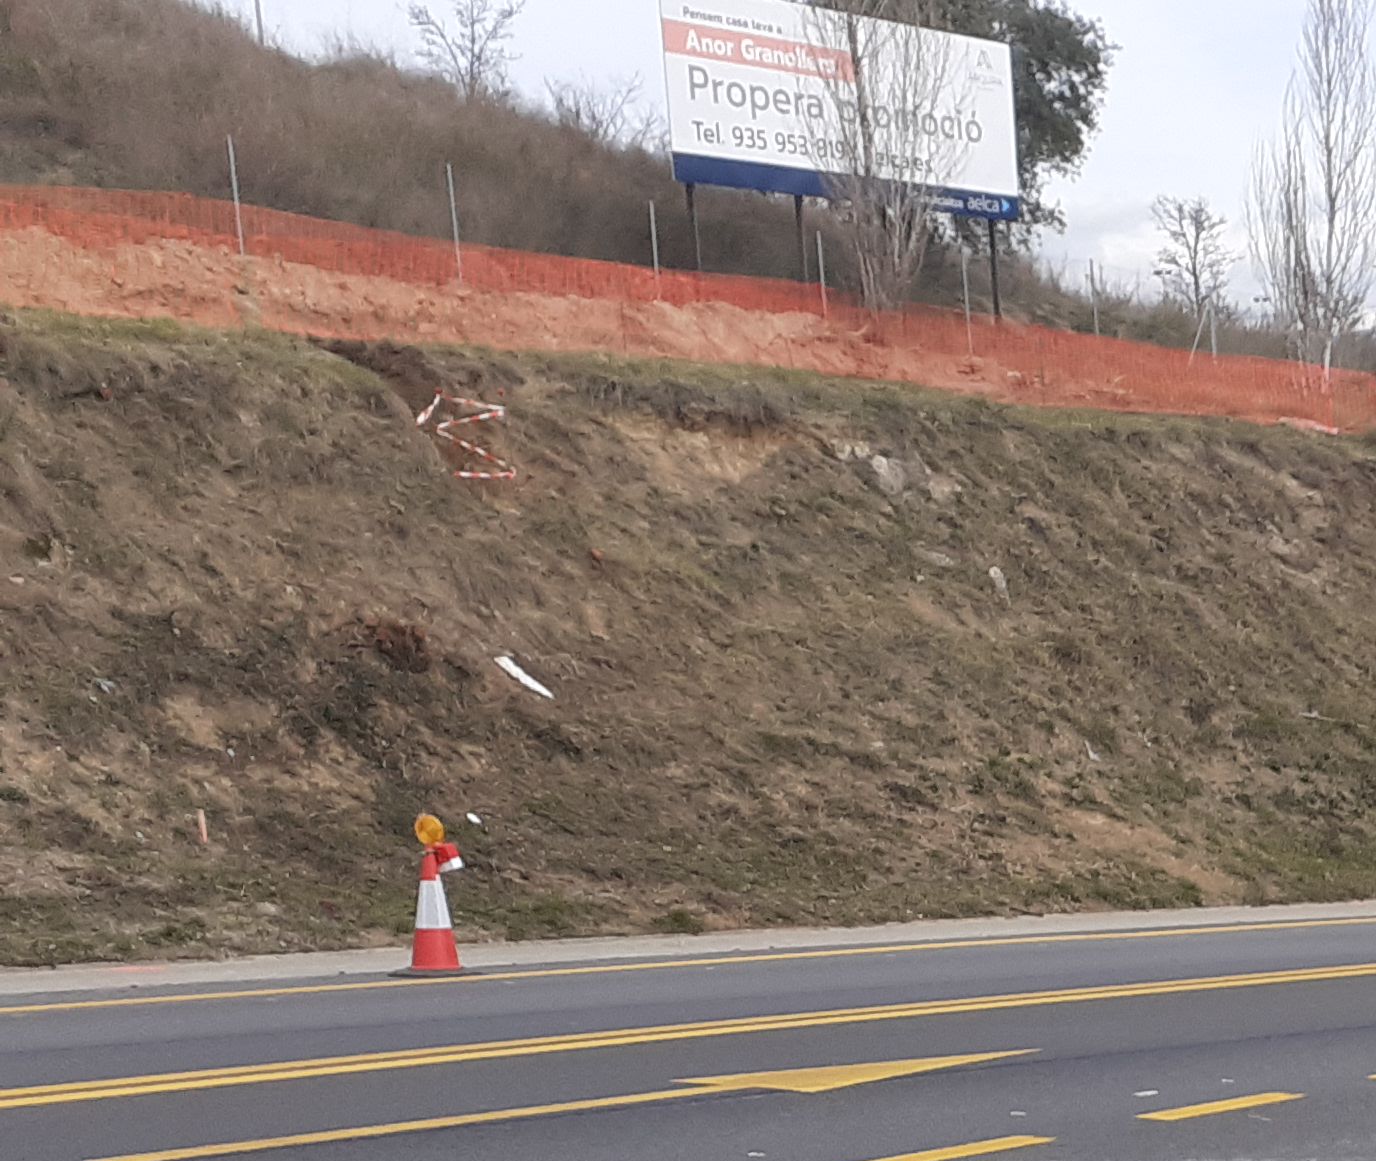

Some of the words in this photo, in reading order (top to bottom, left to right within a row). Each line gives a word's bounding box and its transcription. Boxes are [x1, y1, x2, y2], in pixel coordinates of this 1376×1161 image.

[726, 16, 749, 30] casa
[686, 29, 735, 57] Anor
[741, 38, 836, 74] Granollers
[688, 64, 824, 120] Propera
[840, 100, 983, 143] pomoció
[691, 120, 725, 145] Tel.
[732, 126, 768, 151] 935
[775, 132, 809, 156] 953
